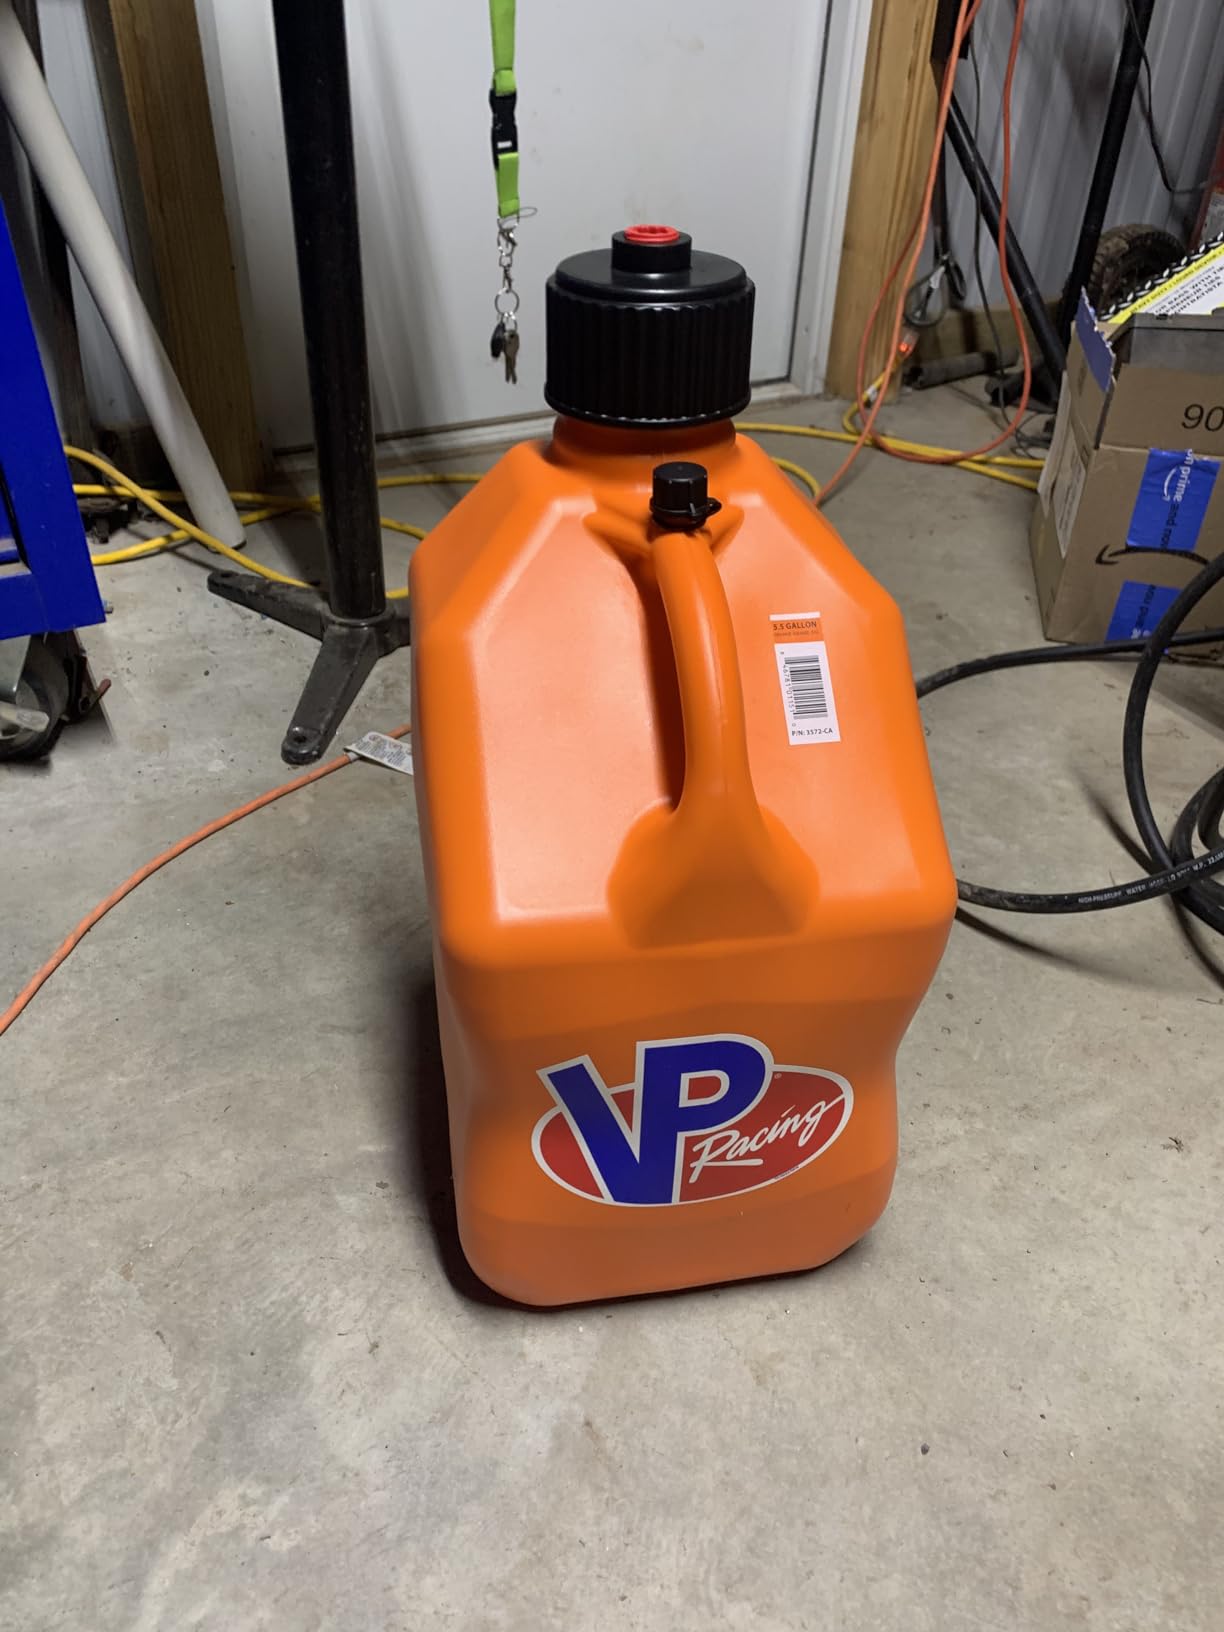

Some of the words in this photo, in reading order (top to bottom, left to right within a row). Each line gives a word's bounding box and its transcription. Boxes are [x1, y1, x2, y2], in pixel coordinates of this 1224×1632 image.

[1172, 465, 1192, 503] prime
[785, 620, 817, 631] GALLON
[806, 727, 834, 736] 3572-CA
[537, 1034, 774, 1206] VP
[688, 1094, 845, 1184] Racing
